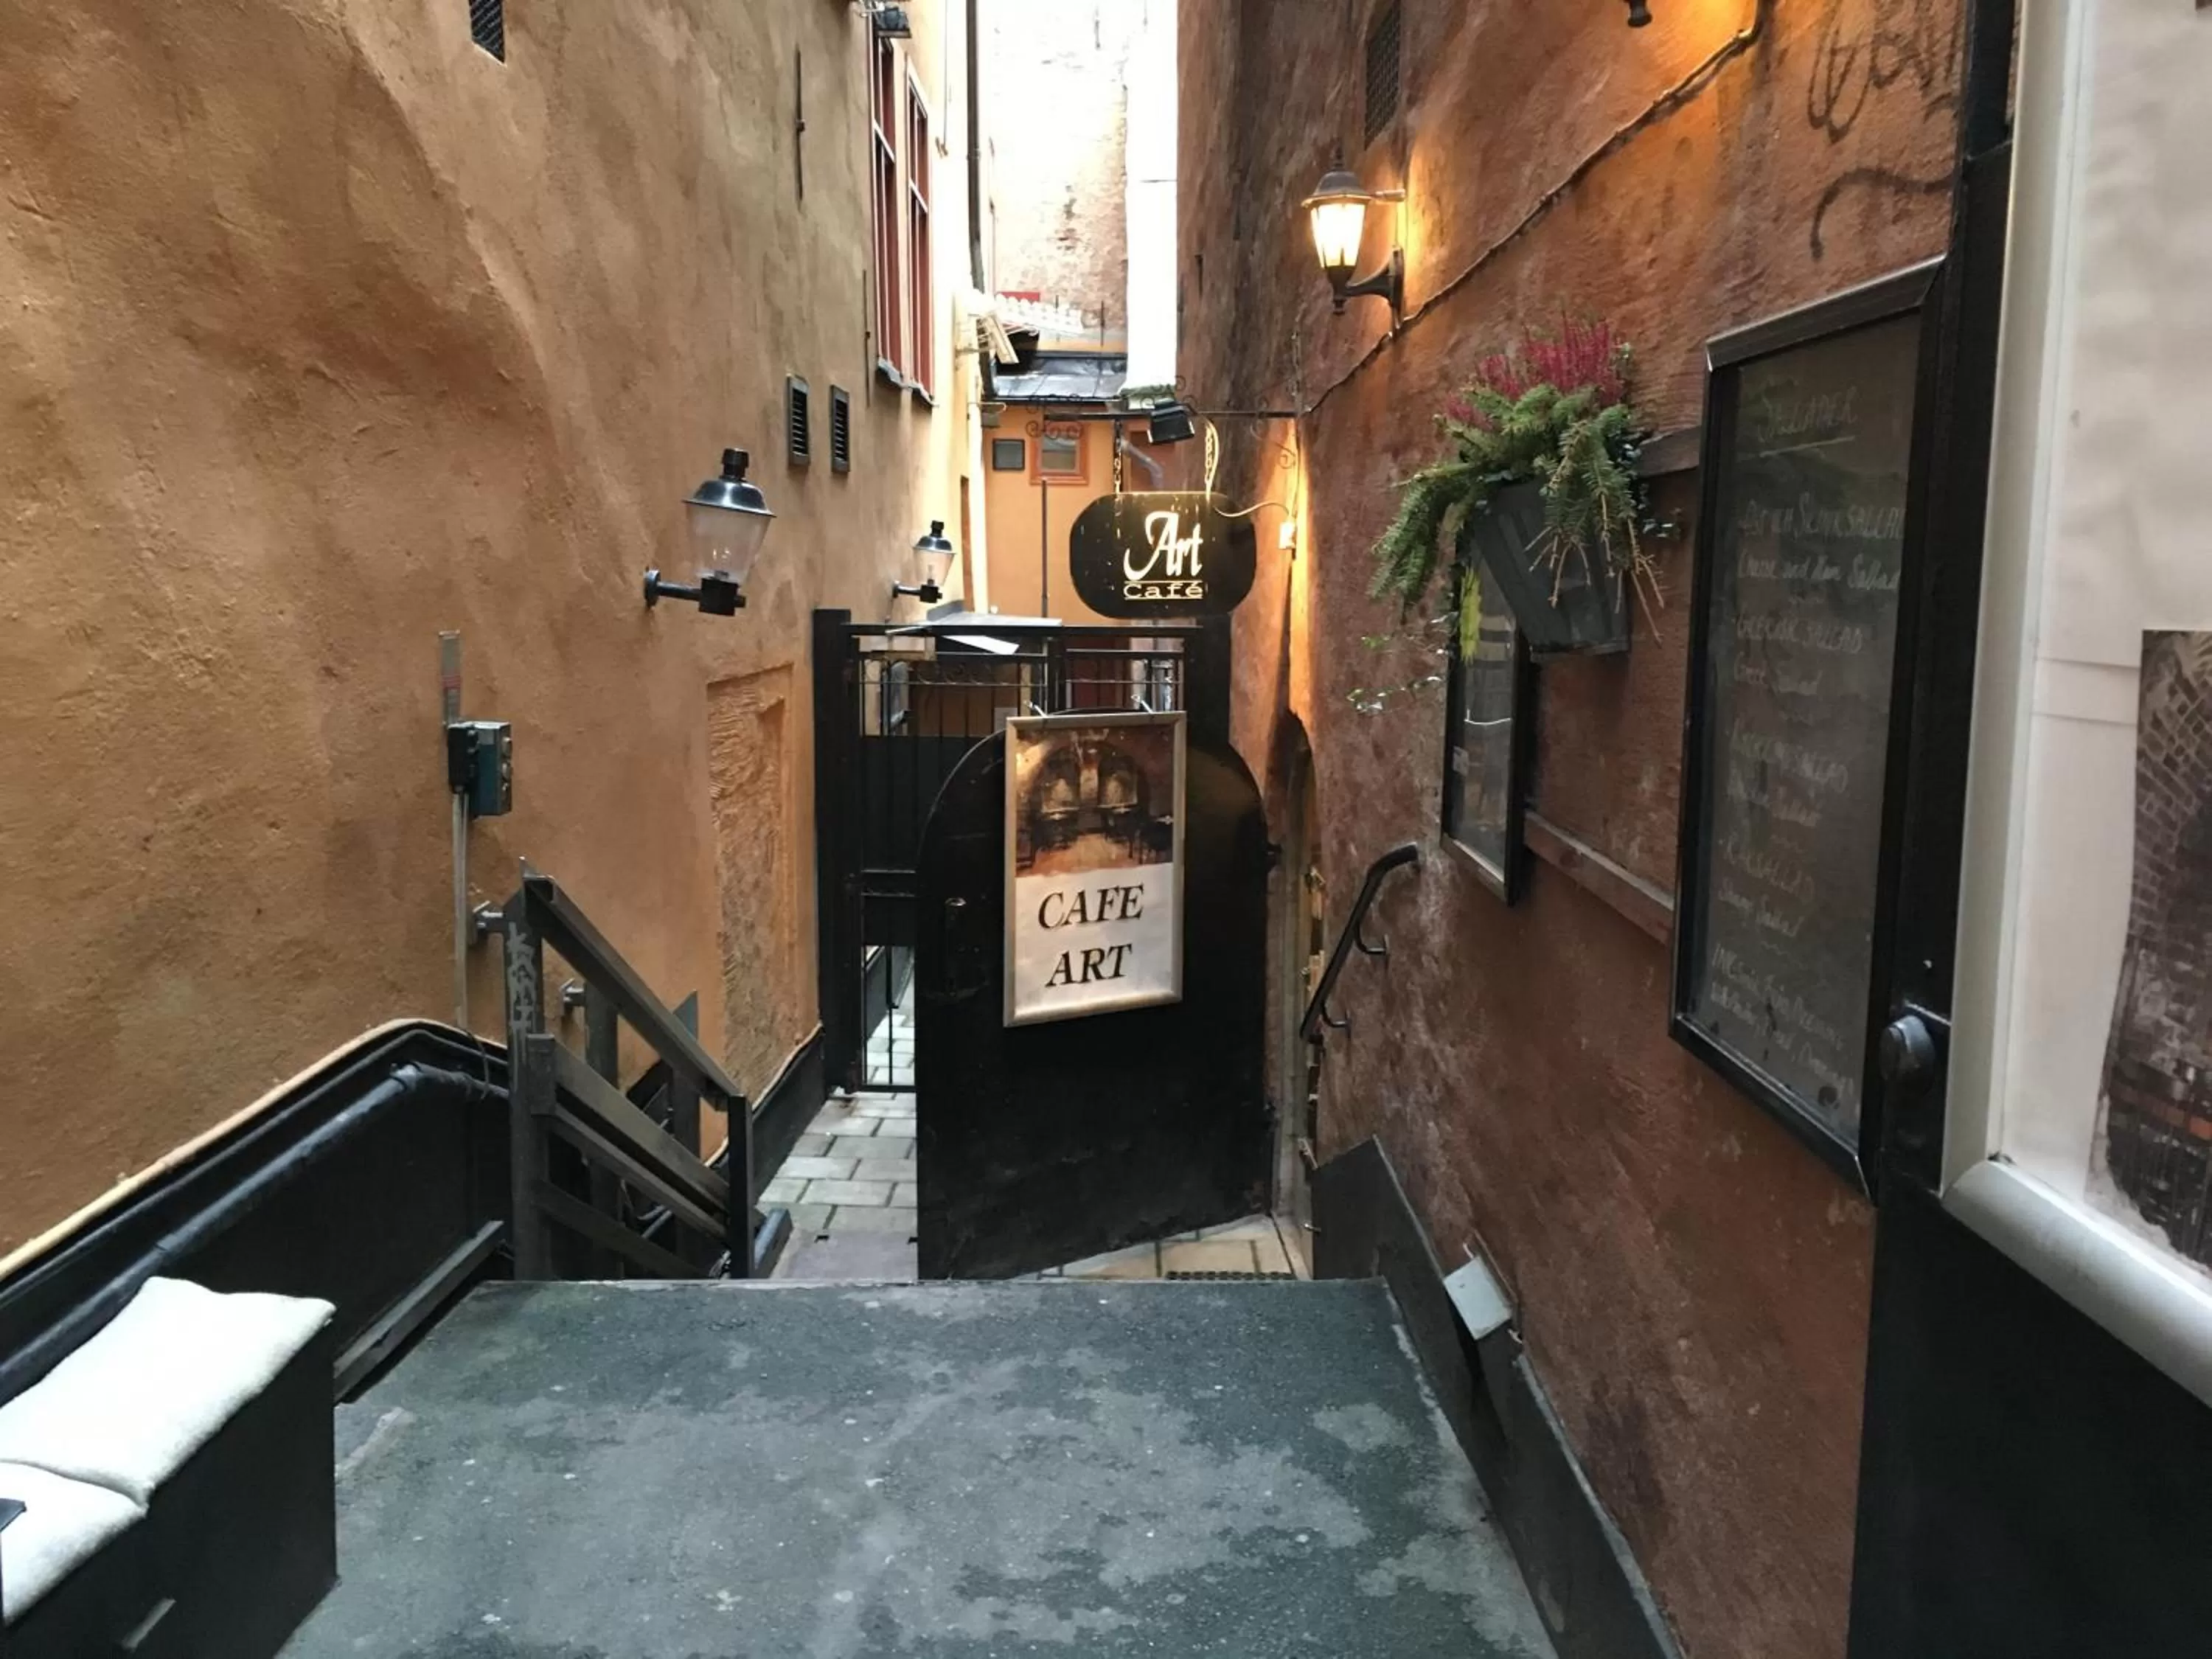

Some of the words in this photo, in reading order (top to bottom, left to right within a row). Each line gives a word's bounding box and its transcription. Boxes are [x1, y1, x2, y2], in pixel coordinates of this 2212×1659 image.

[1124, 510, 1203, 580] Art
[1038, 884, 1144, 929] CAFE
[1045, 944, 1133, 988] ART
